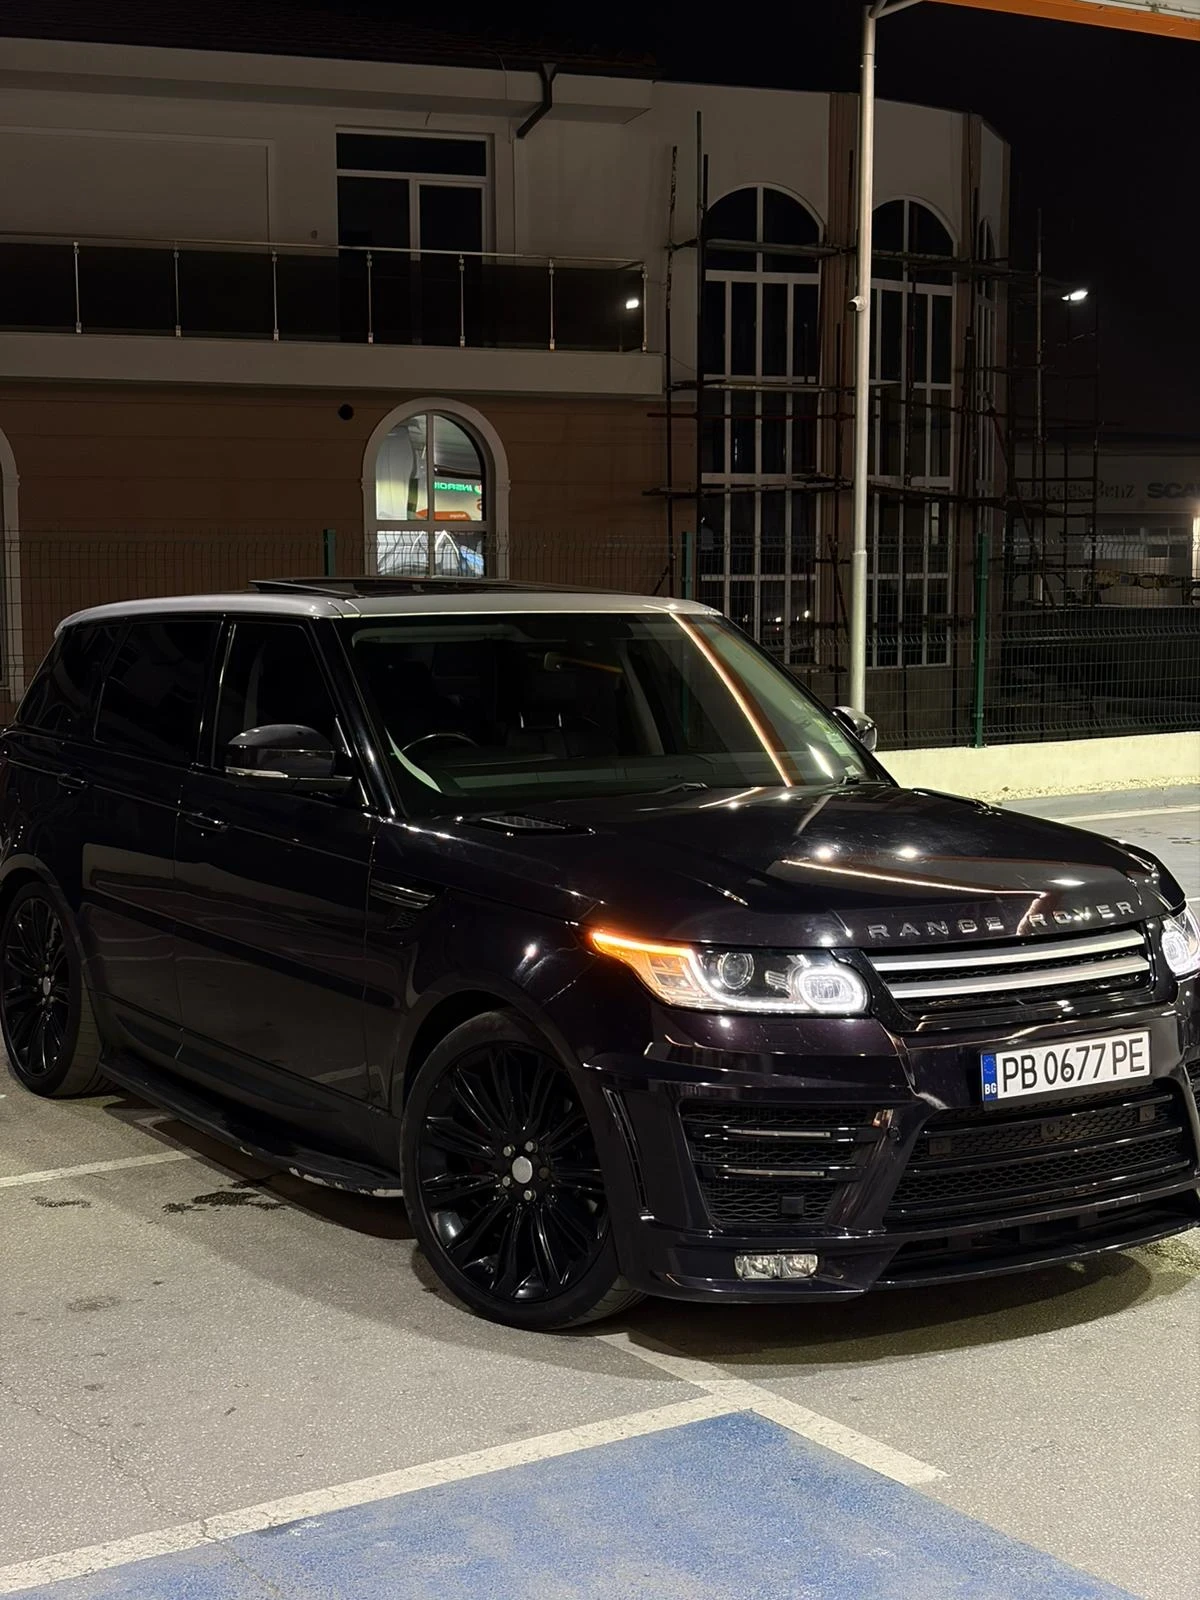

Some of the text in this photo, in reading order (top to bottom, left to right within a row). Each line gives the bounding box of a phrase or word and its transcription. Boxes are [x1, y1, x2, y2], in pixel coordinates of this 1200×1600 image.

[1016, 480, 1135, 498] Mredes-Benz
[867, 901, 1134, 938] RANGE ROVER
[1002, 1038, 1145, 1092] PB 0677 PE
[984, 1083, 997, 1095] BG
